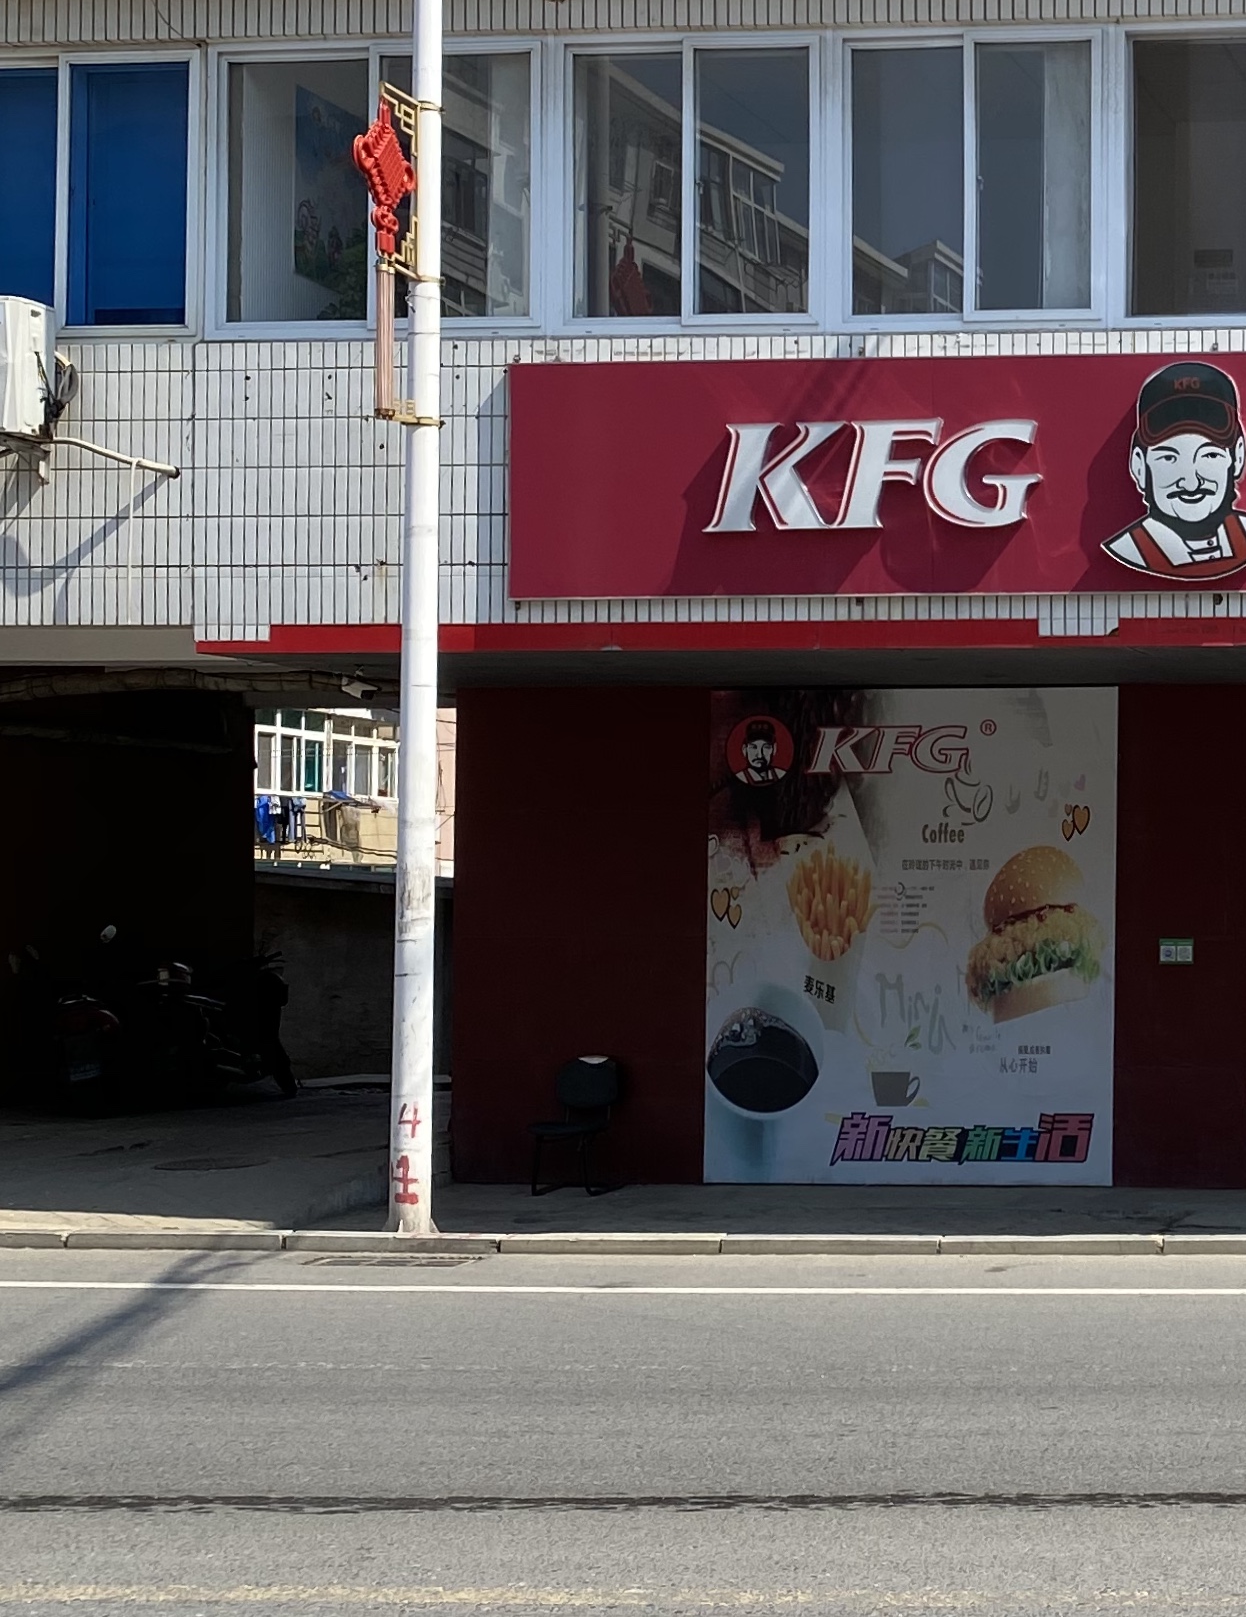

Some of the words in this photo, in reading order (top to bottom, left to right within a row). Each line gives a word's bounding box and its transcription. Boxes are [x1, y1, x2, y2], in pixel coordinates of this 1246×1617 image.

[1173, 376, 1201, 390] KFG
[702, 418, 1044, 534] KFG
[804, 724, 969, 774] KFG
[922, 822, 966, 844] Coffee
[804, 974, 837, 1004] 麦乐基
[999, 1056, 1038, 1074] 从心开始
[397, 1101, 422, 1139] 4
[829, 1111, 1096, 1166] 新快餐新生活
